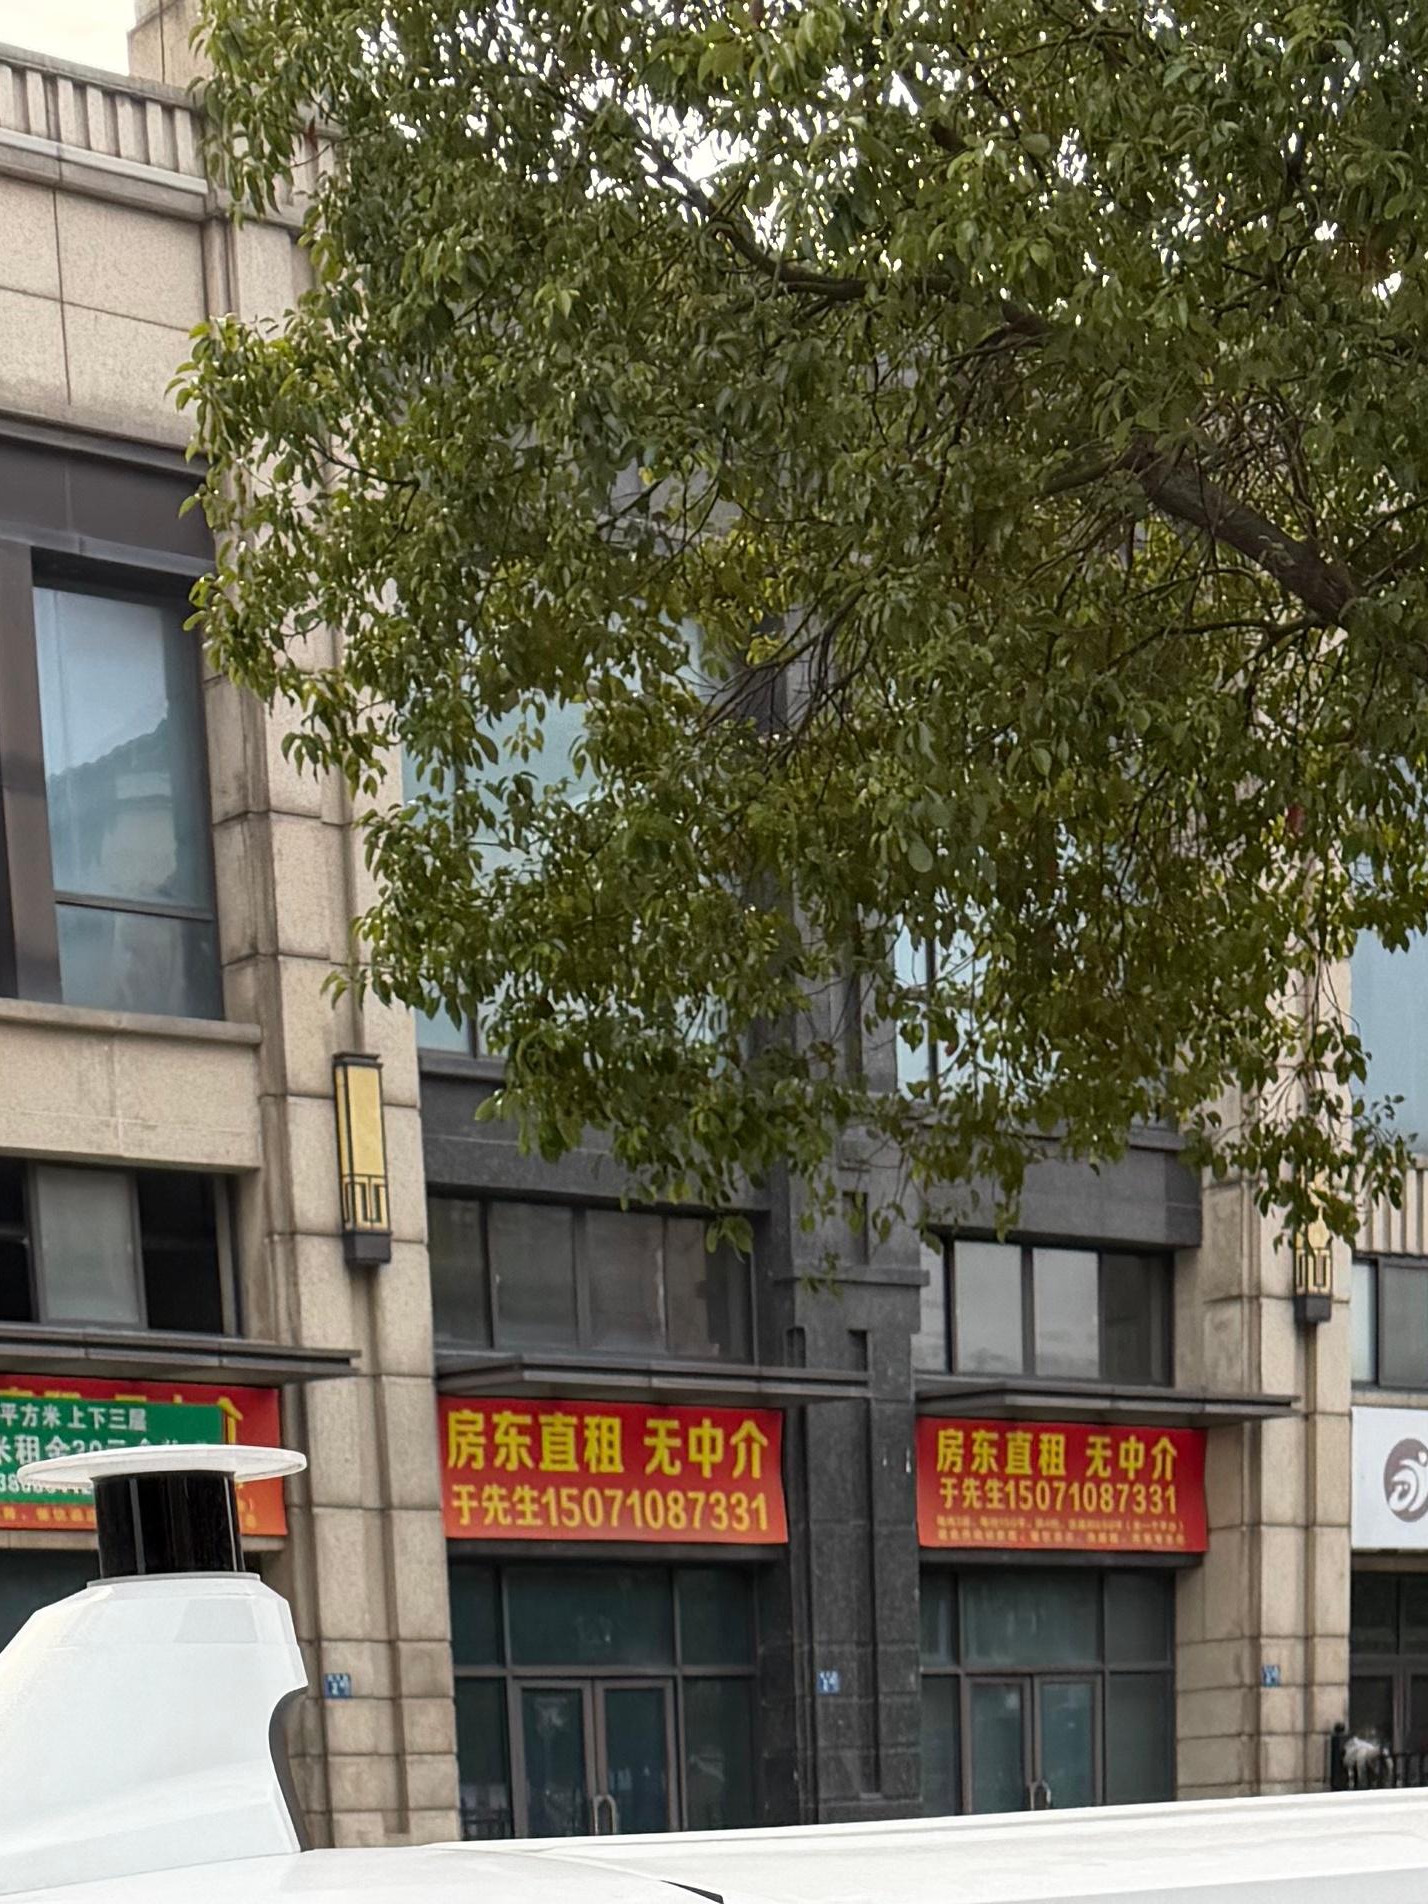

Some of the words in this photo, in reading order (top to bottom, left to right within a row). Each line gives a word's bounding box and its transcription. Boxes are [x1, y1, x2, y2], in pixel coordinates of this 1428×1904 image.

[70, 1405, 148, 1432] 上下三层
[447, 1409, 625, 1474] 房东直租
[643, 1417, 769, 1479] 无中介
[936, 1428, 1066, 1476] 房东直租
[1085, 1434, 1178, 1481] 无中介
[452, 1483, 769, 1531] 于先生15071087331
[939, 1477, 1177, 1514] 于先生15071087331
